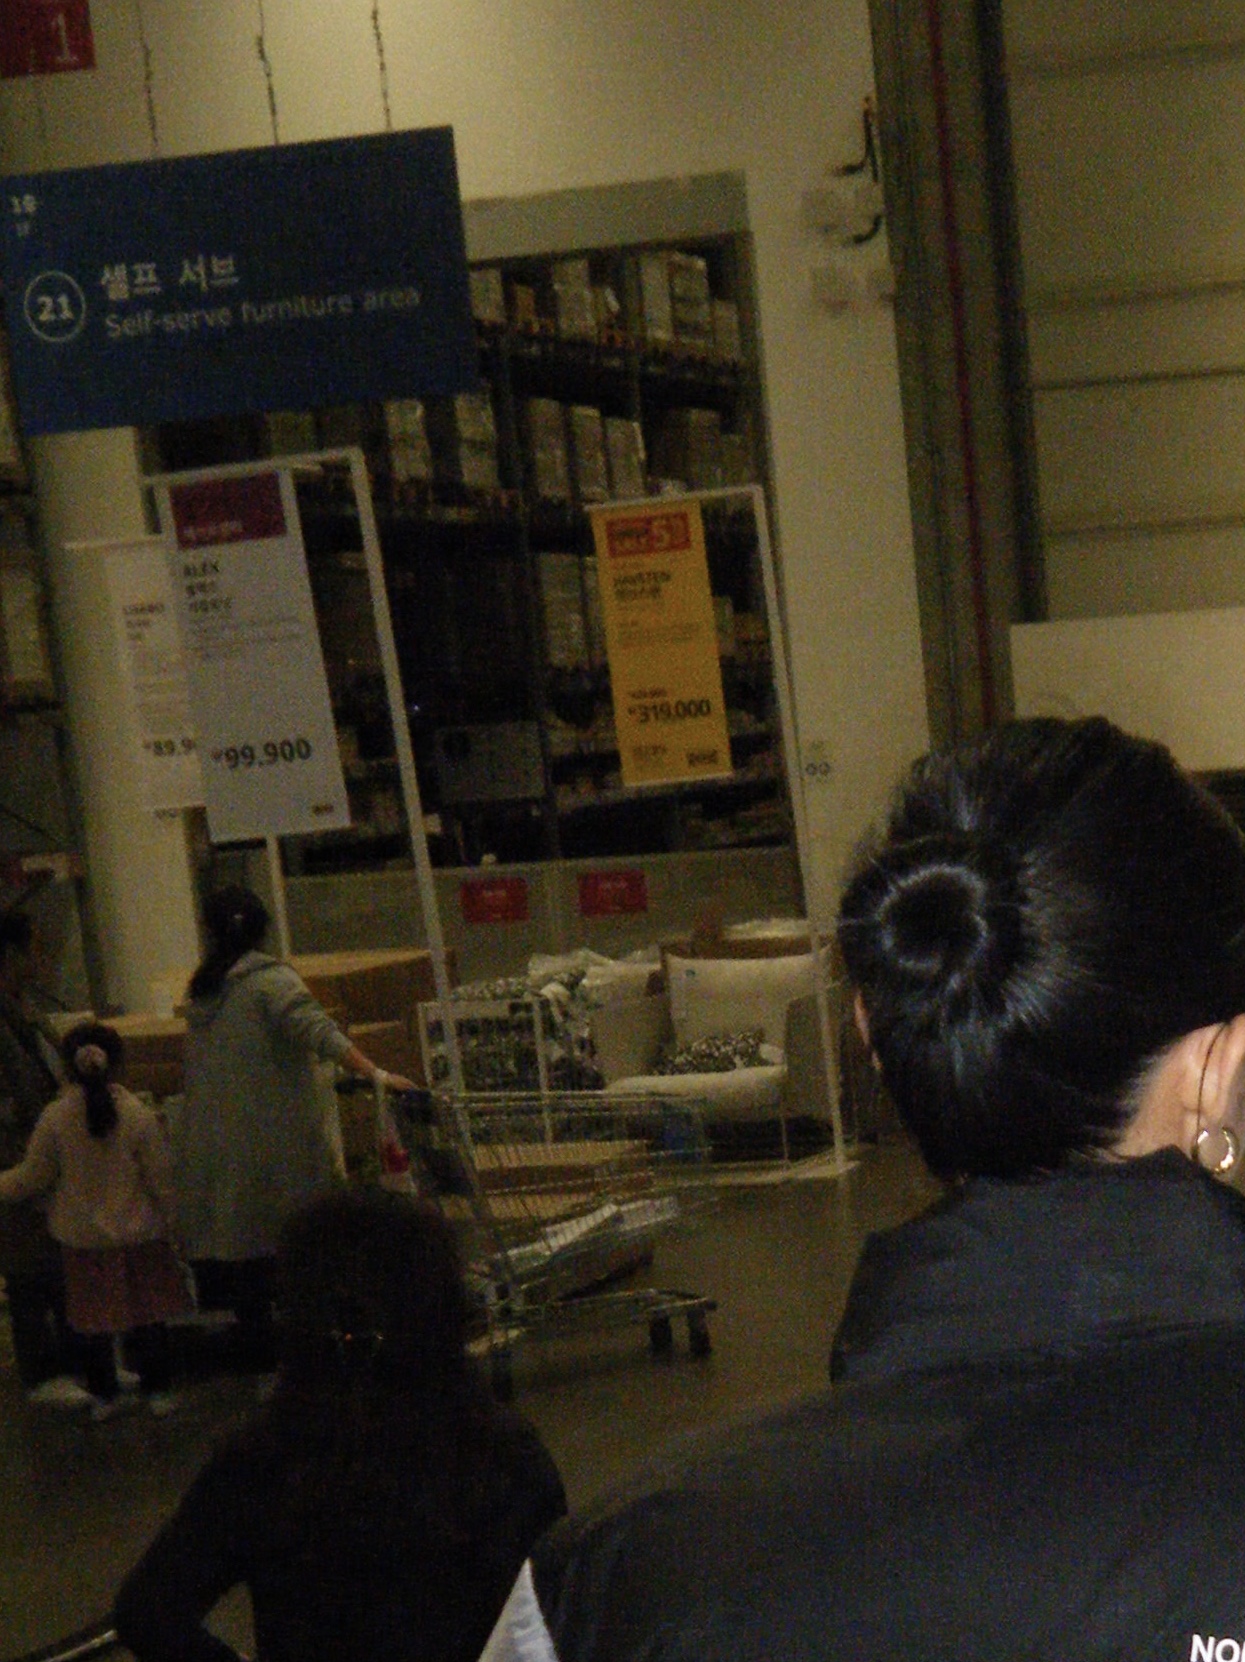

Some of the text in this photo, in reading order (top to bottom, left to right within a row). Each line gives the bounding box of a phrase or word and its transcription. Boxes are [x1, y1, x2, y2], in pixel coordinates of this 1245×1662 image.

[101, 253, 239, 300] 셀프 서브
[36, 295, 72, 322] 21
[106, 306, 233, 341] Self-serve
[240, 293, 355, 325] furniture
